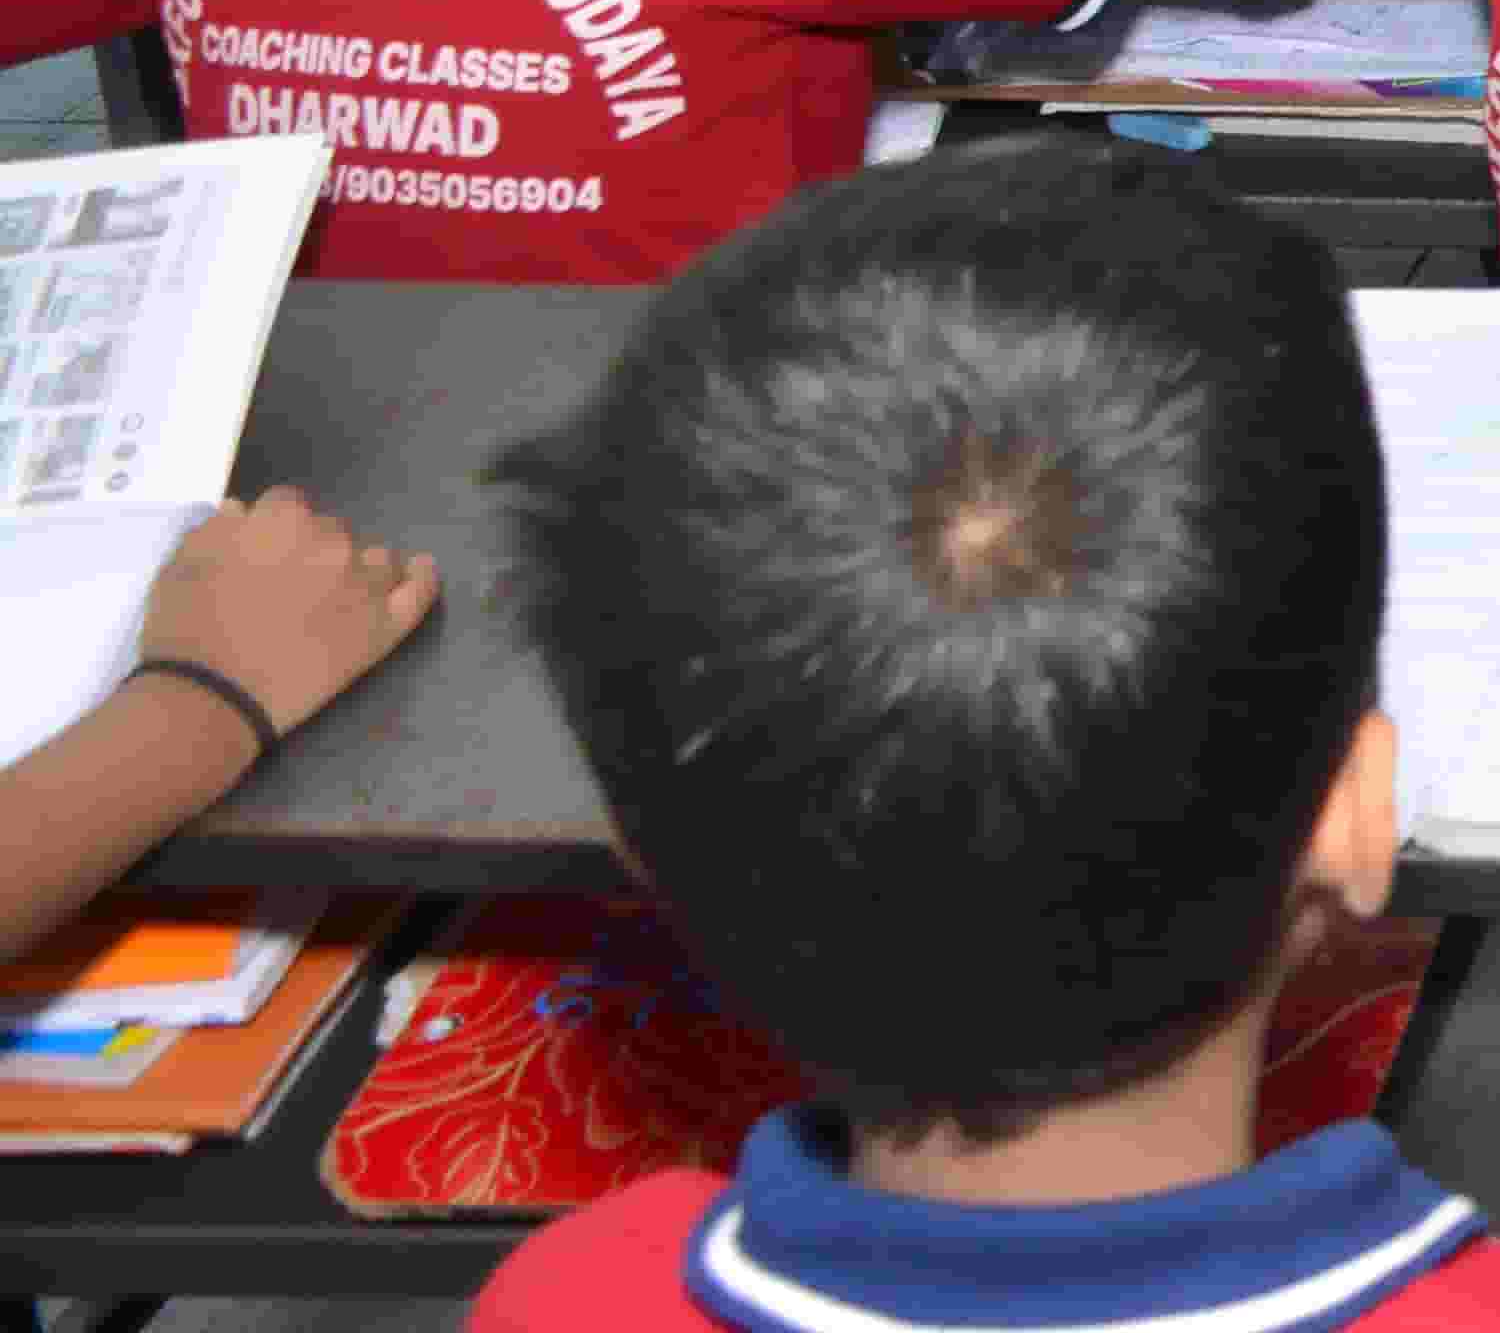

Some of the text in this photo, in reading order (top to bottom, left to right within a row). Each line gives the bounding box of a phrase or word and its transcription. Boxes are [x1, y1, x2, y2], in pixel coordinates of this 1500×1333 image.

[201, 24, 572, 95] COACHING CLASSES
[228, 84, 499, 158] DHARWAD
